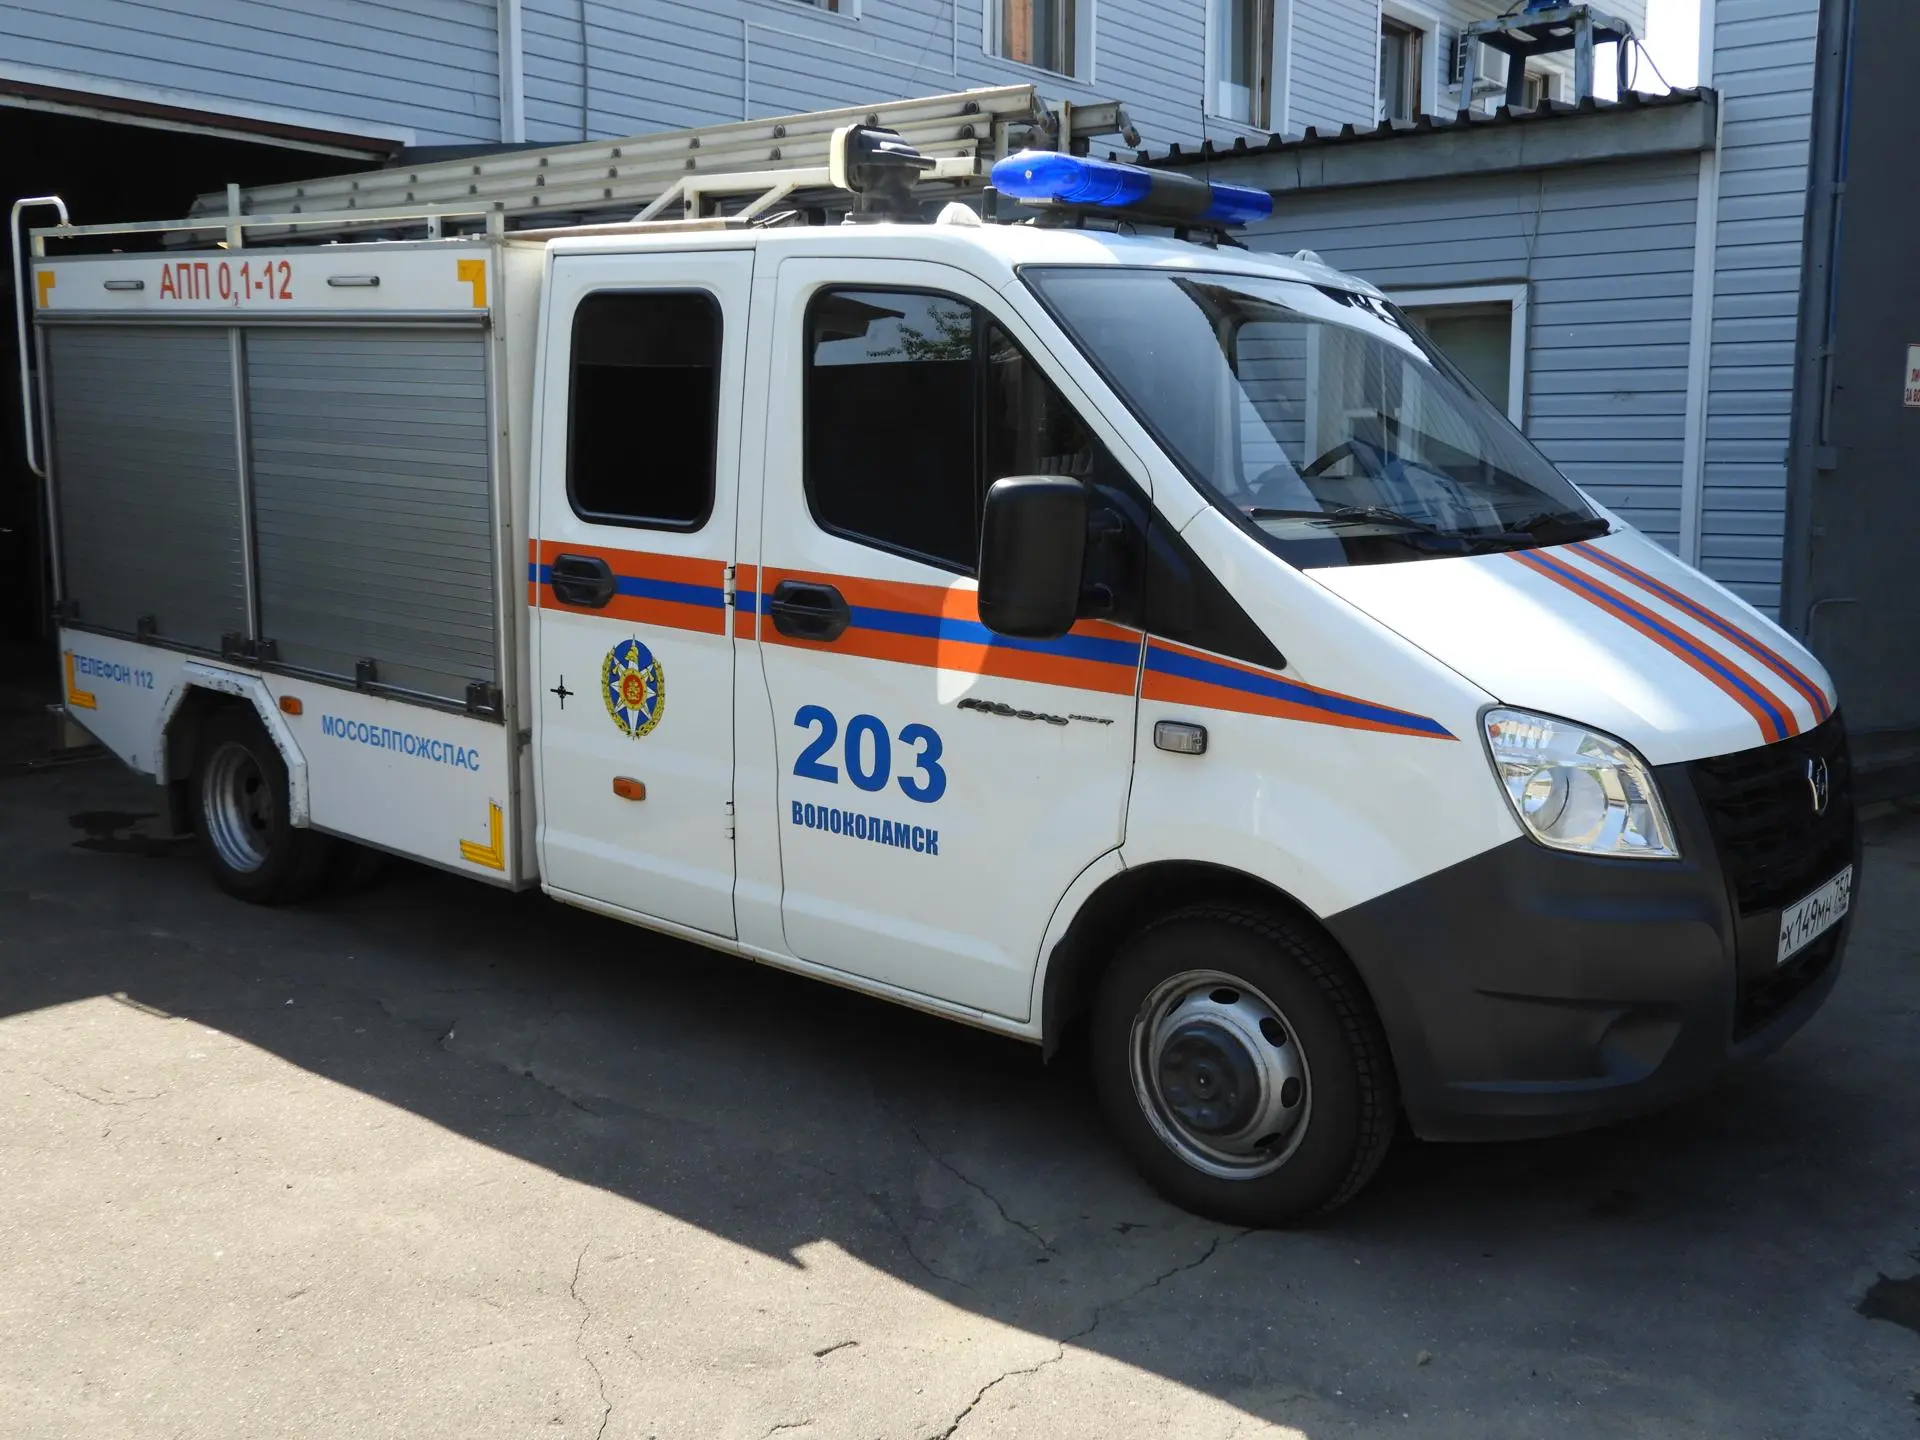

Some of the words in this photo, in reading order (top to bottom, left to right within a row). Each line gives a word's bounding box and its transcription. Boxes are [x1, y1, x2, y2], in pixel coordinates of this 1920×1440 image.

[160, 263, 210, 299] АПП
[218, 260, 293, 306] 0,1-12
[73, 654, 130, 685] ТЕЛЕФОН
[134, 669, 154, 690] 112
[322, 714, 480, 772] МОСОБЛПОЖСПАС
[793, 704, 947, 803] 203
[791, 800, 938, 856] ВОЛОКОЛАМСК
